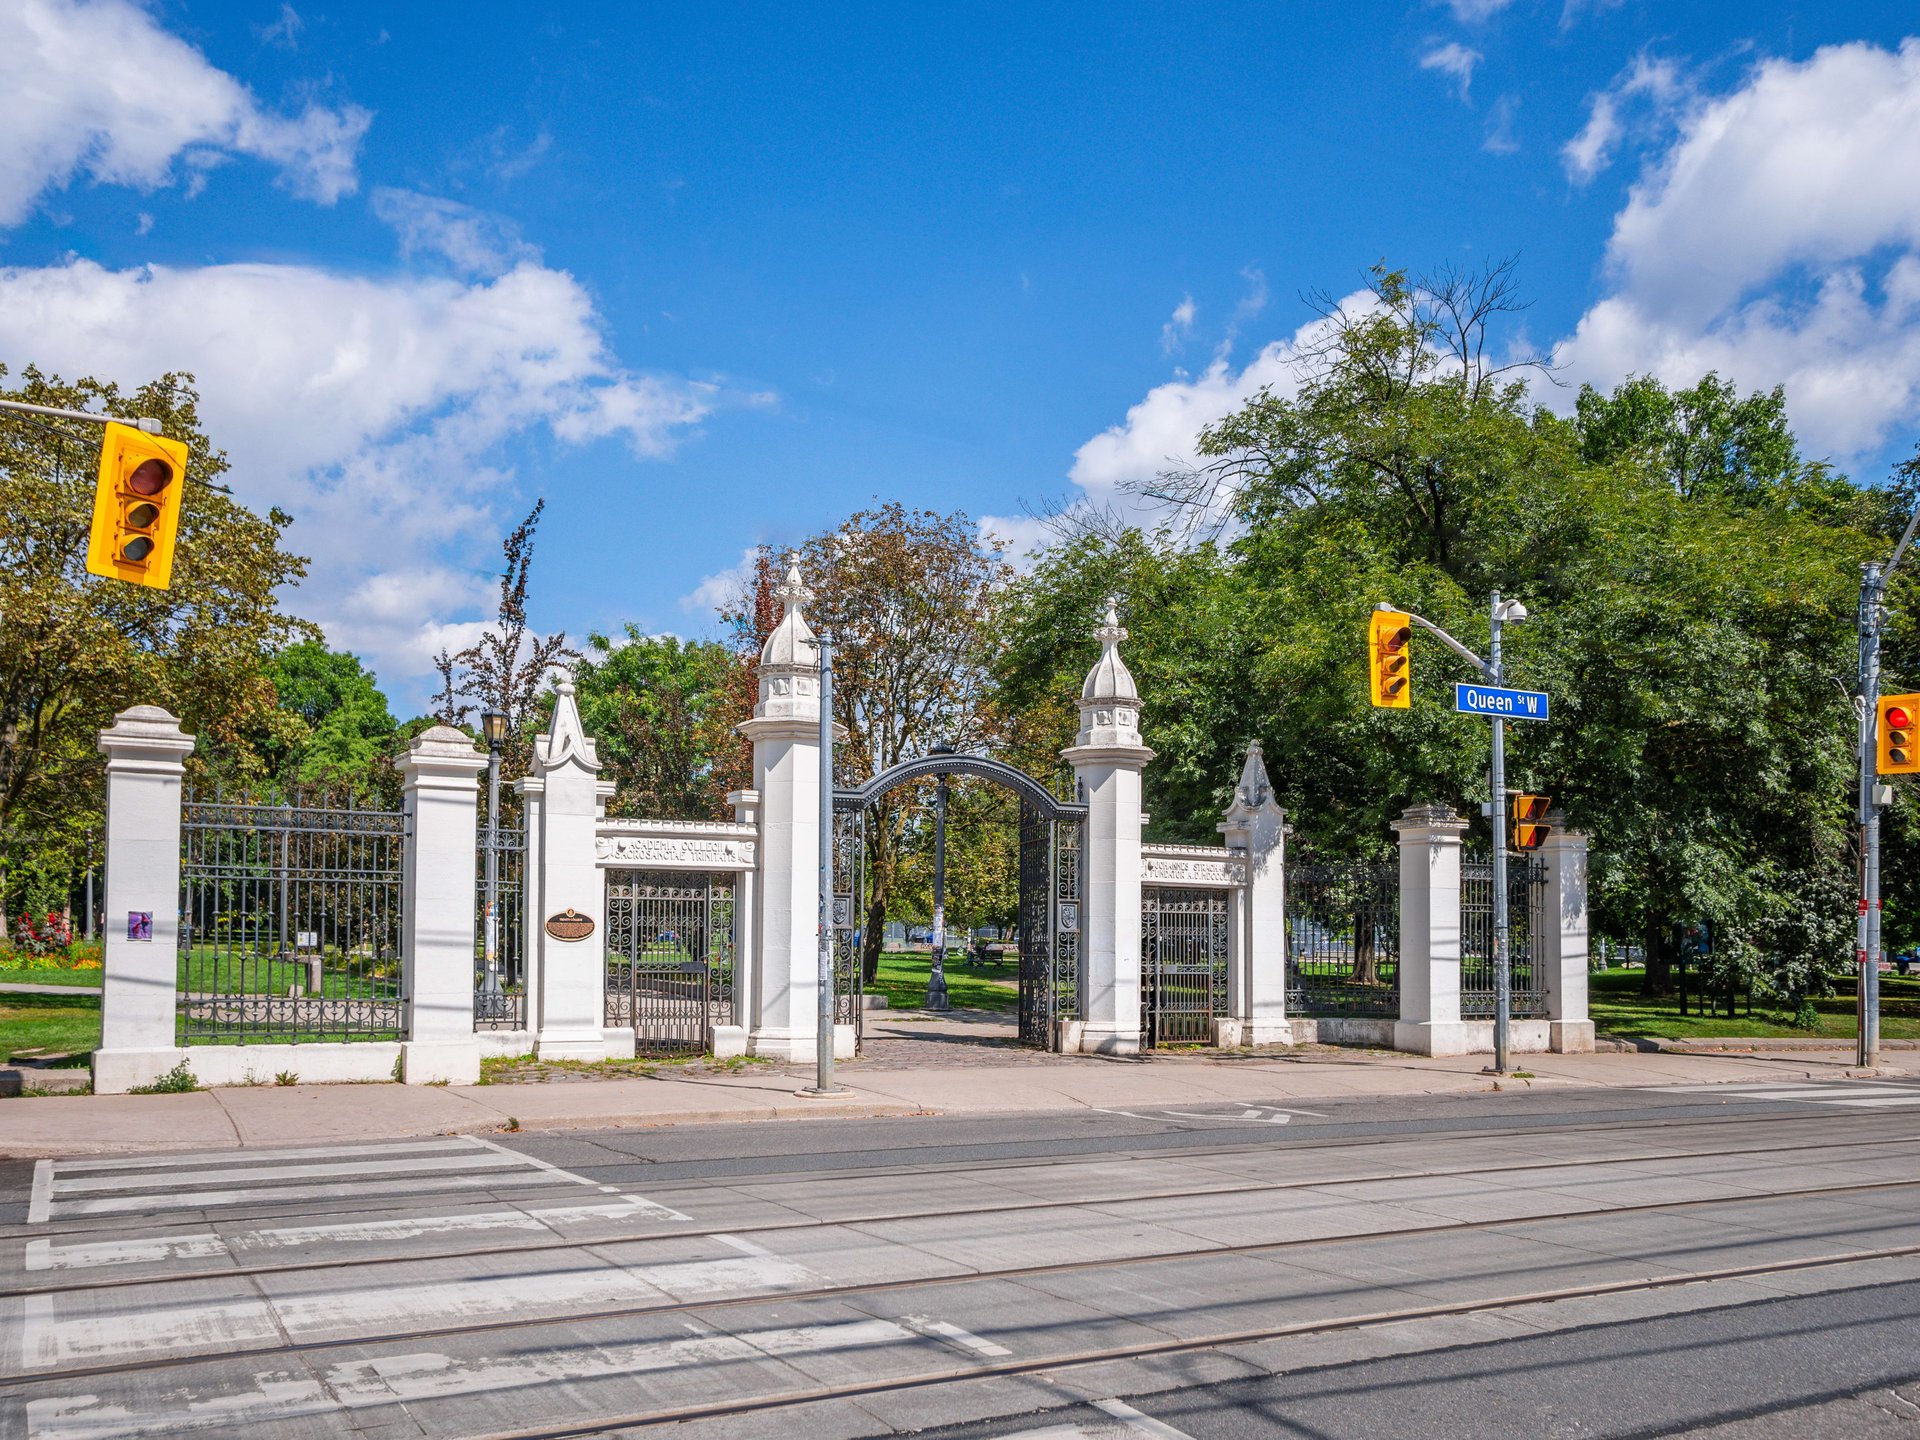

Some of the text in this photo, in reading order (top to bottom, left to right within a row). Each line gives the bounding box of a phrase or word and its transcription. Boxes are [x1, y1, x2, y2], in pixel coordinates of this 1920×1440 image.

[1467, 689, 1538, 713] Queen St W
[628, 840, 677, 851] ACADEMIA
[1154, 861, 1189, 871] JOHANNES
